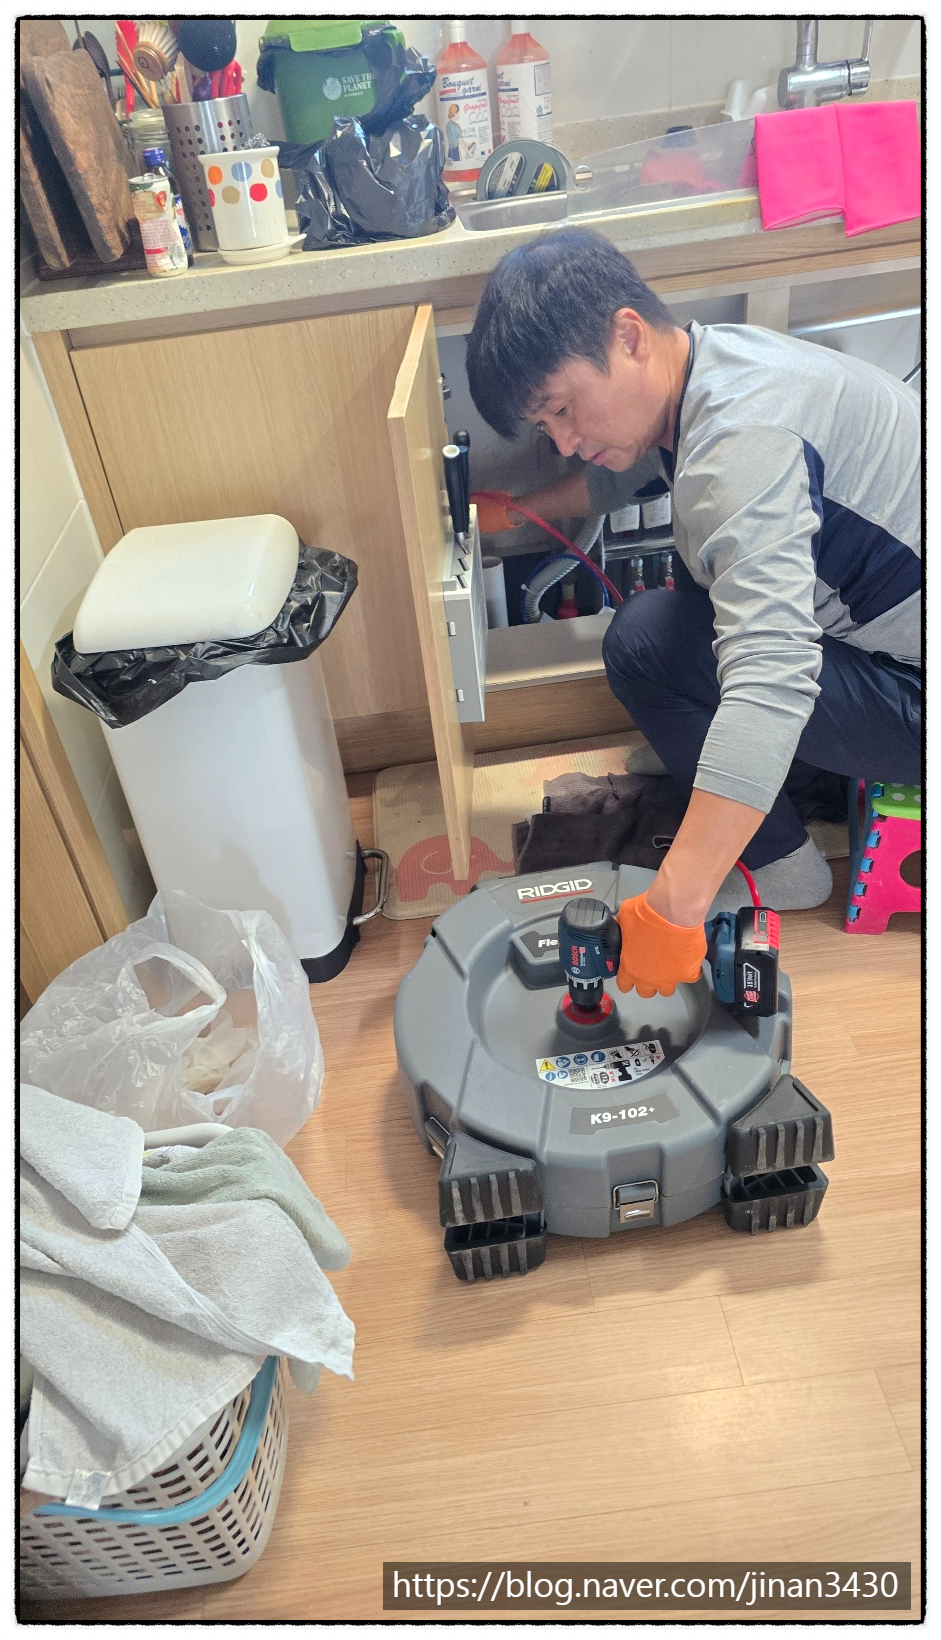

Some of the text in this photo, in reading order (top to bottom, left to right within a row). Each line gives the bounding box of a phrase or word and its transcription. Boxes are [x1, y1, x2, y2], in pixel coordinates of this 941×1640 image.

[341, 75, 361, 84] SAVE
[442, 77, 475, 90] Bouquet
[343, 81, 371, 92] PLANET
[517, 879, 592, 900] RIDGID
[571, 945, 579, 966] BOSCH
